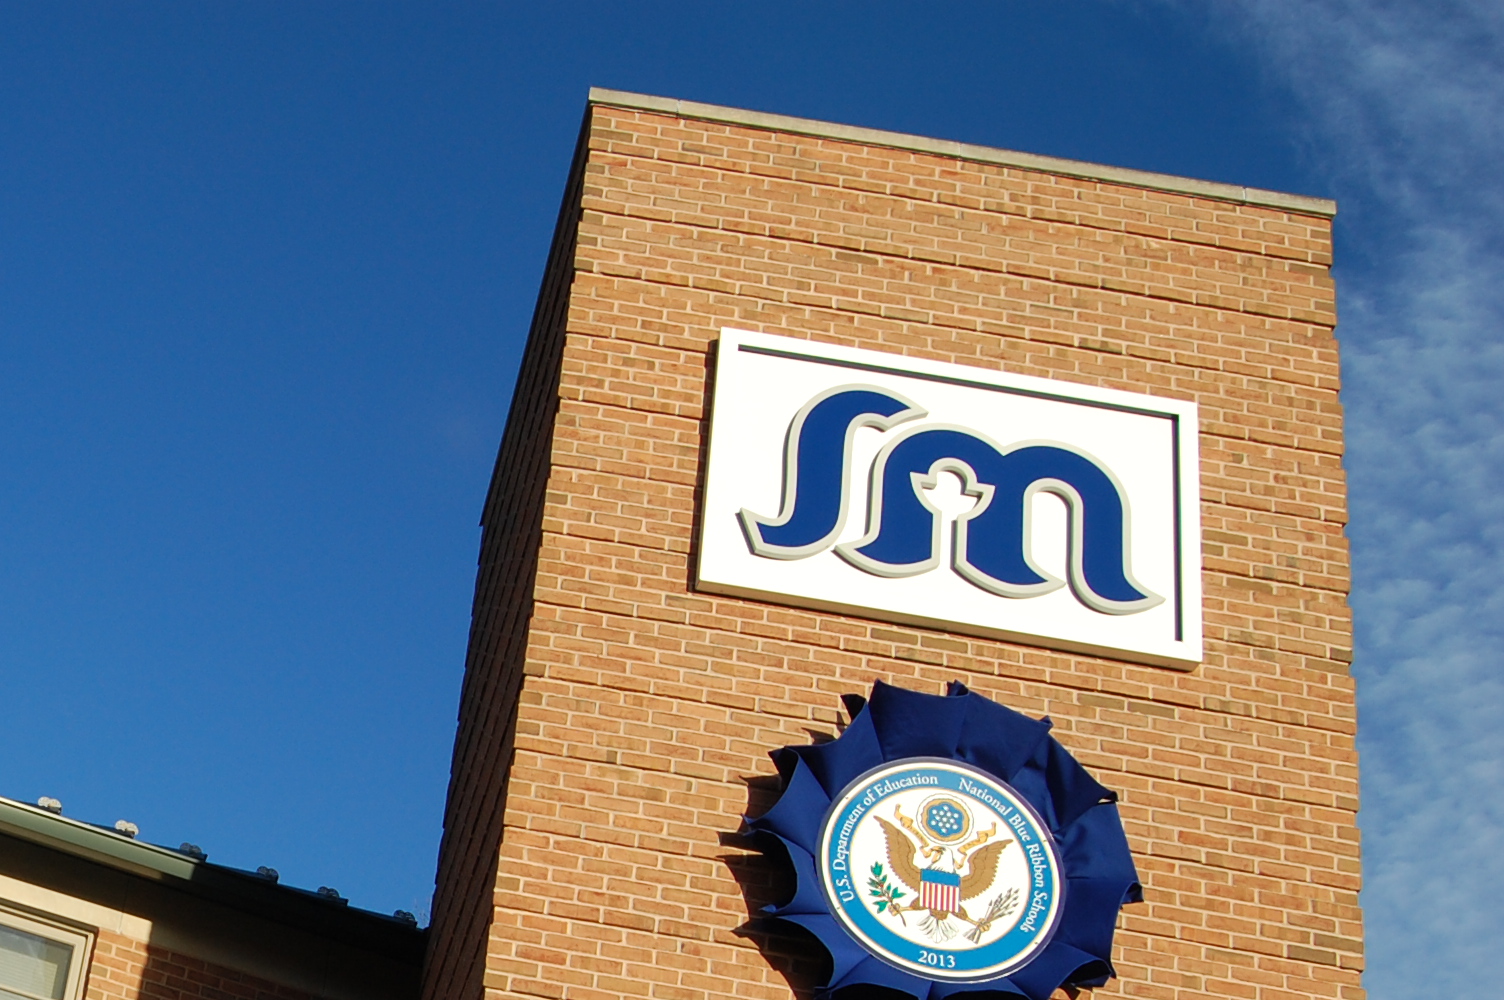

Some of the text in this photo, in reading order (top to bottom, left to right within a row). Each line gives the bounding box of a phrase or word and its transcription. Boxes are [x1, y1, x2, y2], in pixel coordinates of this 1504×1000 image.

[833, 774, 939, 903] U.S. Department of Education
[958, 777, 1048, 933] National Blue Ribbon Schools
[918, 950, 956, 968] 2013
